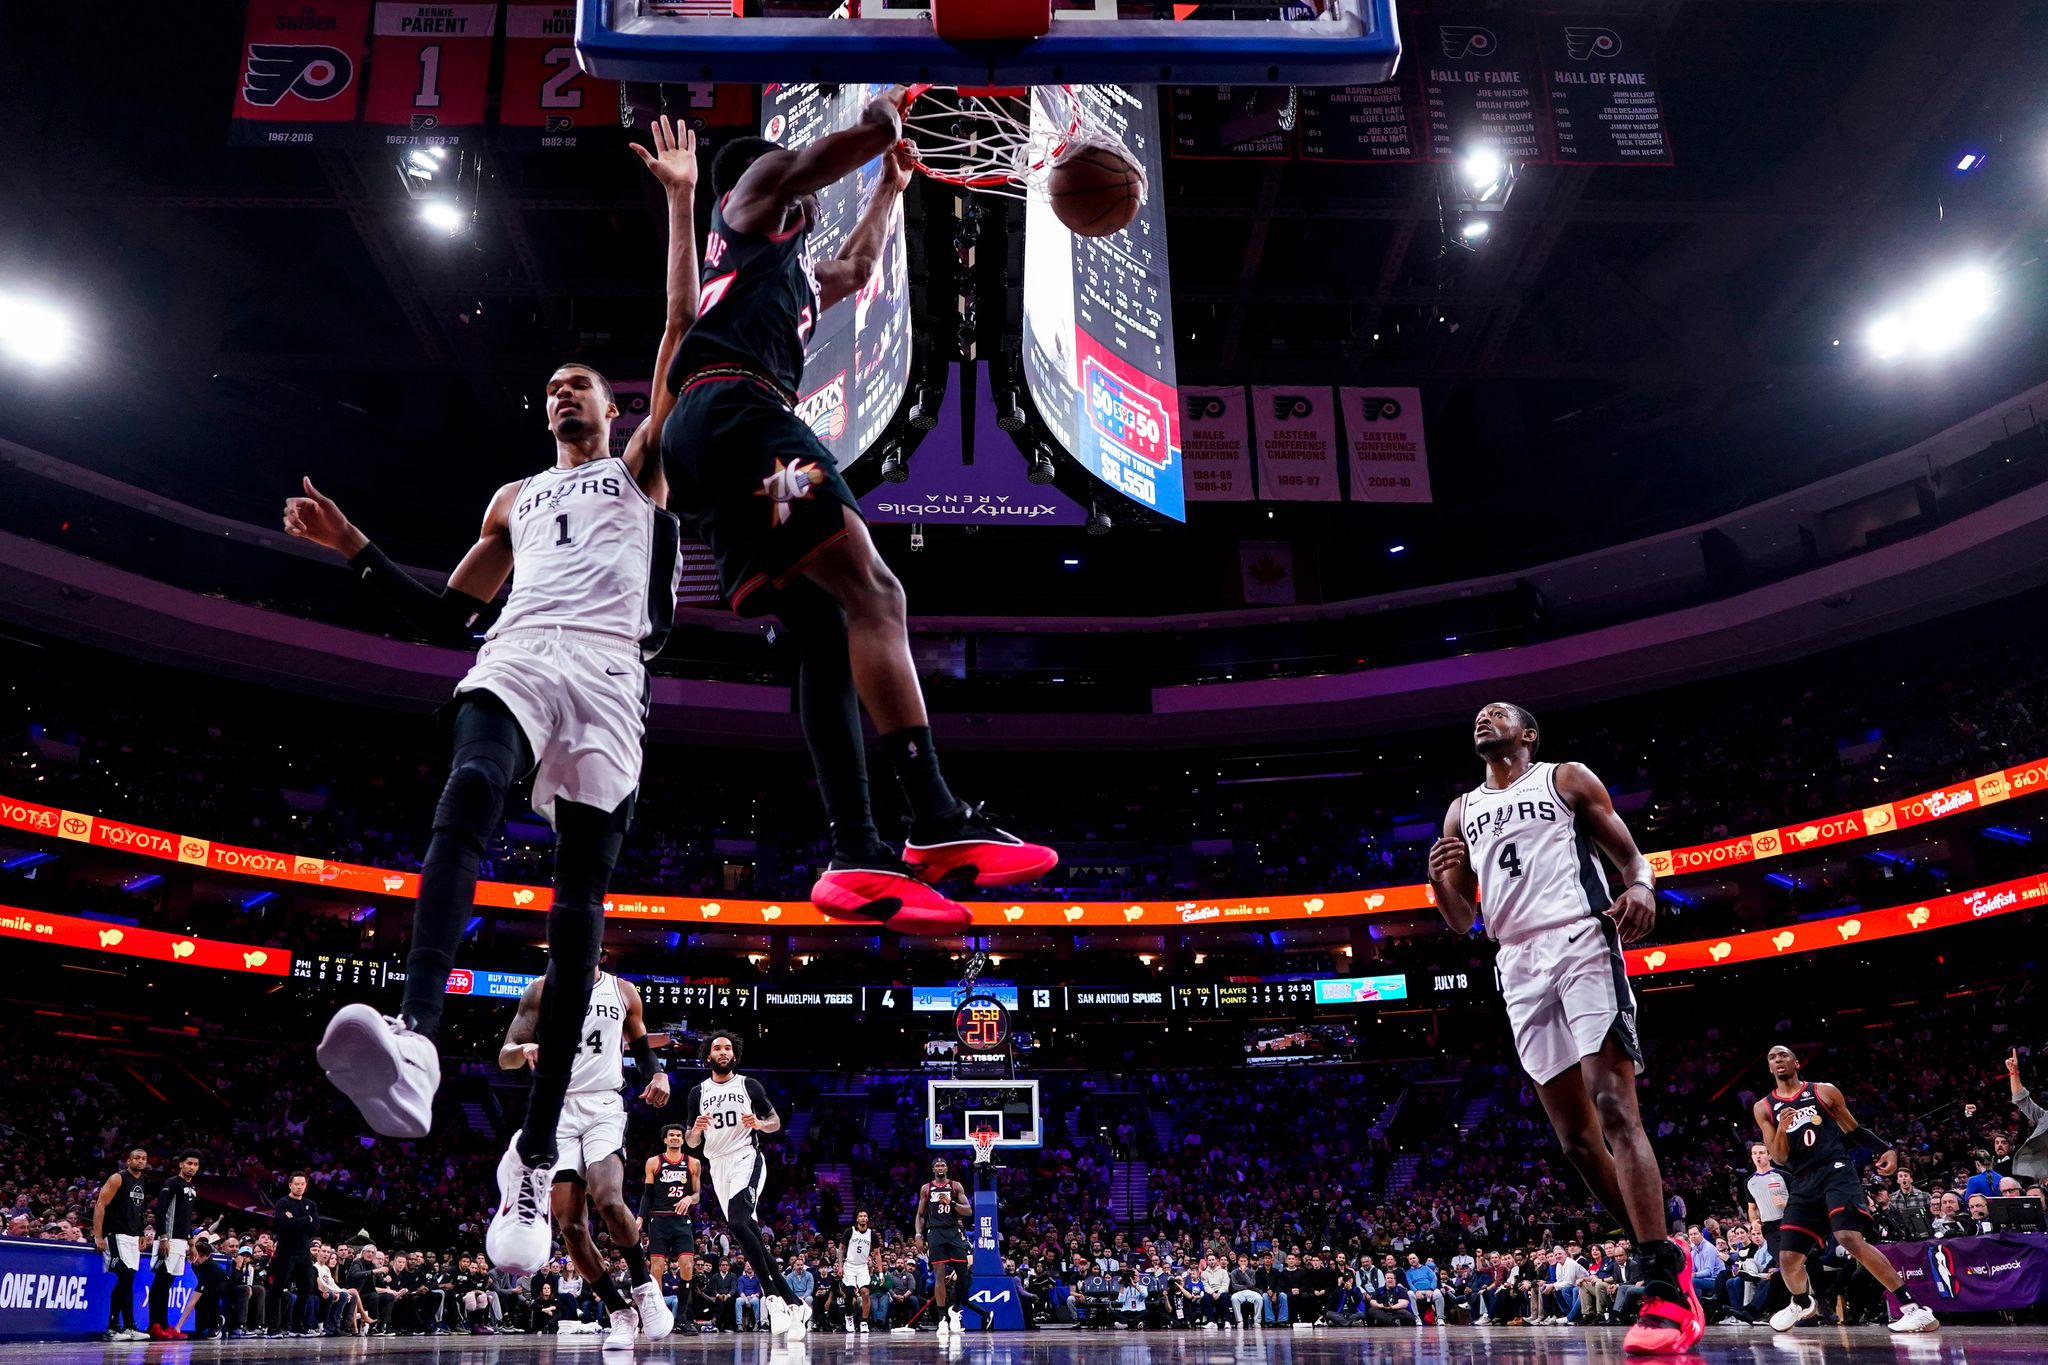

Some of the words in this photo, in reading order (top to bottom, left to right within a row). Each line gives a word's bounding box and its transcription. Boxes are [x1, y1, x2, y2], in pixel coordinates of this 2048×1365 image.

[418, 8, 454, 17] BERNIE
[401, 18, 468, 33] PARENT
[414, 44, 442, 108] 1
[540, 46, 583, 108] 2
[1430, 69, 1462, 83] HALL
[1465, 71, 1480, 83] OF
[1485, 71, 1521, 83] FAME
[1555, 71, 1587, 83] HALL
[1591, 72, 1606, 83] OF
[1610, 72, 1646, 84] FAME
[1476, 89, 1492, 97] JOE
[1494, 89, 1529, 97] WATSON
[1476, 100, 1501, 109] BRIAN
[788, 103, 811, 123] MAXEY
[1482, 112, 1506, 121] MARK
[1508, 111, 1533, 120] HOWE
[797, 114, 823, 137] QUENTIN
[268, 133, 314, 143] 1967-2016
[425, 136, 459, 145] 1973-79
[541, 137, 577, 147] 1982-92
[1136, 133, 1144, 143] FLS
[1370, 135, 1387, 143] VAN
[1371, 148, 1387, 156] TIM
[1141, 219, 1150, 229] FLS
[810, 227, 840, 255] STATS
[1142, 249, 1151, 259] FLS
[1114, 251, 1146, 279] STATS
[1132, 277, 1140, 286] TO
[1148, 286, 1157, 296] FLS
[1084, 284, 1110, 310] TEAM
[1111, 306, 1157, 339] LEADERS
[1093, 383, 1112, 416] 50
[1136, 412, 1160, 443] 50
[1193, 430, 1225, 440] WALES
[1273, 430, 1317, 440] EASTERN
[1363, 431, 1406, 442] EASTERN
[1265, 440, 1327, 451] CONFERENCE
[1355, 441, 1417, 452] CONFERENCE
[1182, 450, 1239, 460] CHAMPIONS
[1267, 450, 1326, 461] CHAMPIONS
[1358, 451, 1416, 462] CHAMPIONS
[1132, 457, 1156, 479] TOTAL
[1101, 452, 1156, 505] $6,550
[1368, 477, 1411, 488] 2009-10
[518, 478, 620, 520] SPURS
[926, 494, 1010, 503] ARENA
[878, 503, 966, 515] mobile
[972, 504, 1057, 517] xfinity
[555, 513, 572, 546] 1
[1932, 789, 1973, 817] Goldfish
[1, 803, 52, 828] YOTA
[1466, 801, 1556, 846] SPURS
[1786, 818, 1859, 846] TYOTA
[99, 824, 172, 853] TOYOTA
[1498, 842, 1522, 879] 4
[1679, 842, 1748, 867] TOYOTA
[215, 849, 287, 873] TOYOTA
[618, 903, 648, 913] smile
[651, 904, 665, 913] on
[1972, 890, 2016, 917] Goldfish
[1182, 906, 1220, 923] Goldfish
[1224, 904, 1253, 916] smile
[1256, 906, 1270, 914] on
[35, 922, 53, 935] on
[296, 959, 311, 969] PHI
[320, 963, 326, 971] 6
[354, 967, 360, 975] 2
[294, 969, 311, 978] SAS
[319, 971, 326, 980] 8
[336, 974, 342, 982] 3
[353, 975, 359, 983] 2
[371, 977, 375, 985] 1
[388, 972, 406, 981] 8:23
[456, 977, 469, 987] 50
[1434, 975, 1455, 991] JULY
[1456, 974, 1468, 989] 18
[659, 986, 665, 994] 5
[670, 987, 680, 995] 25
[697, 988, 707, 996] 77
[736, 988, 750, 996] TOL
[1219, 987, 1248, 995] PLAYER
[1252, 986, 1257, 994] 1
[1277, 985, 1283, 993] 5
[1301, 984, 1312, 992] 30
[672, 996, 678, 1004] 0
[699, 997, 705, 1005] 0
[720, 996, 728, 1007] 4
[739, 997, 747, 1007] 7
[766, 993, 821, 1004] PHILADELPHIA
[824, 993, 853, 1004] 76ERS
[882, 990, 895, 1008] 4
[1032, 989, 1051, 1008] 13
[1077, 993, 1094, 1004] SAN
[1096, 993, 1130, 1004] ANTONIO
[1132, 993, 1162, 1003] SPURS
[1183, 997, 1188, 1007] 1
[1200, 996, 1208, 1006] 7
[1221, 996, 1247, 1004] POINTS
[1265, 995, 1271, 1003] 5
[1278, 994, 1284, 1002] 4
[972, 1009, 1000, 1021] 6:58
[967, 1021, 998, 1044] 20
[973, 1054, 1006, 1062] TISSOT
[703, 1093, 745, 1110] SPURS
[713, 1111, 737, 1129] 30
[1804, 1129, 1816, 1147] 0
[667, 1186, 684, 1198] 25
[938, 1204, 951, 1214] 30
[980, 1217, 992, 1227] GET
[980, 1227, 992, 1237] THE
[983, 1237, 995, 1249] App
[1991, 1259, 2021, 1275] peacock
[0, 1273, 36, 1309] ONE
[38, 1275, 89, 1310] PLACE.
